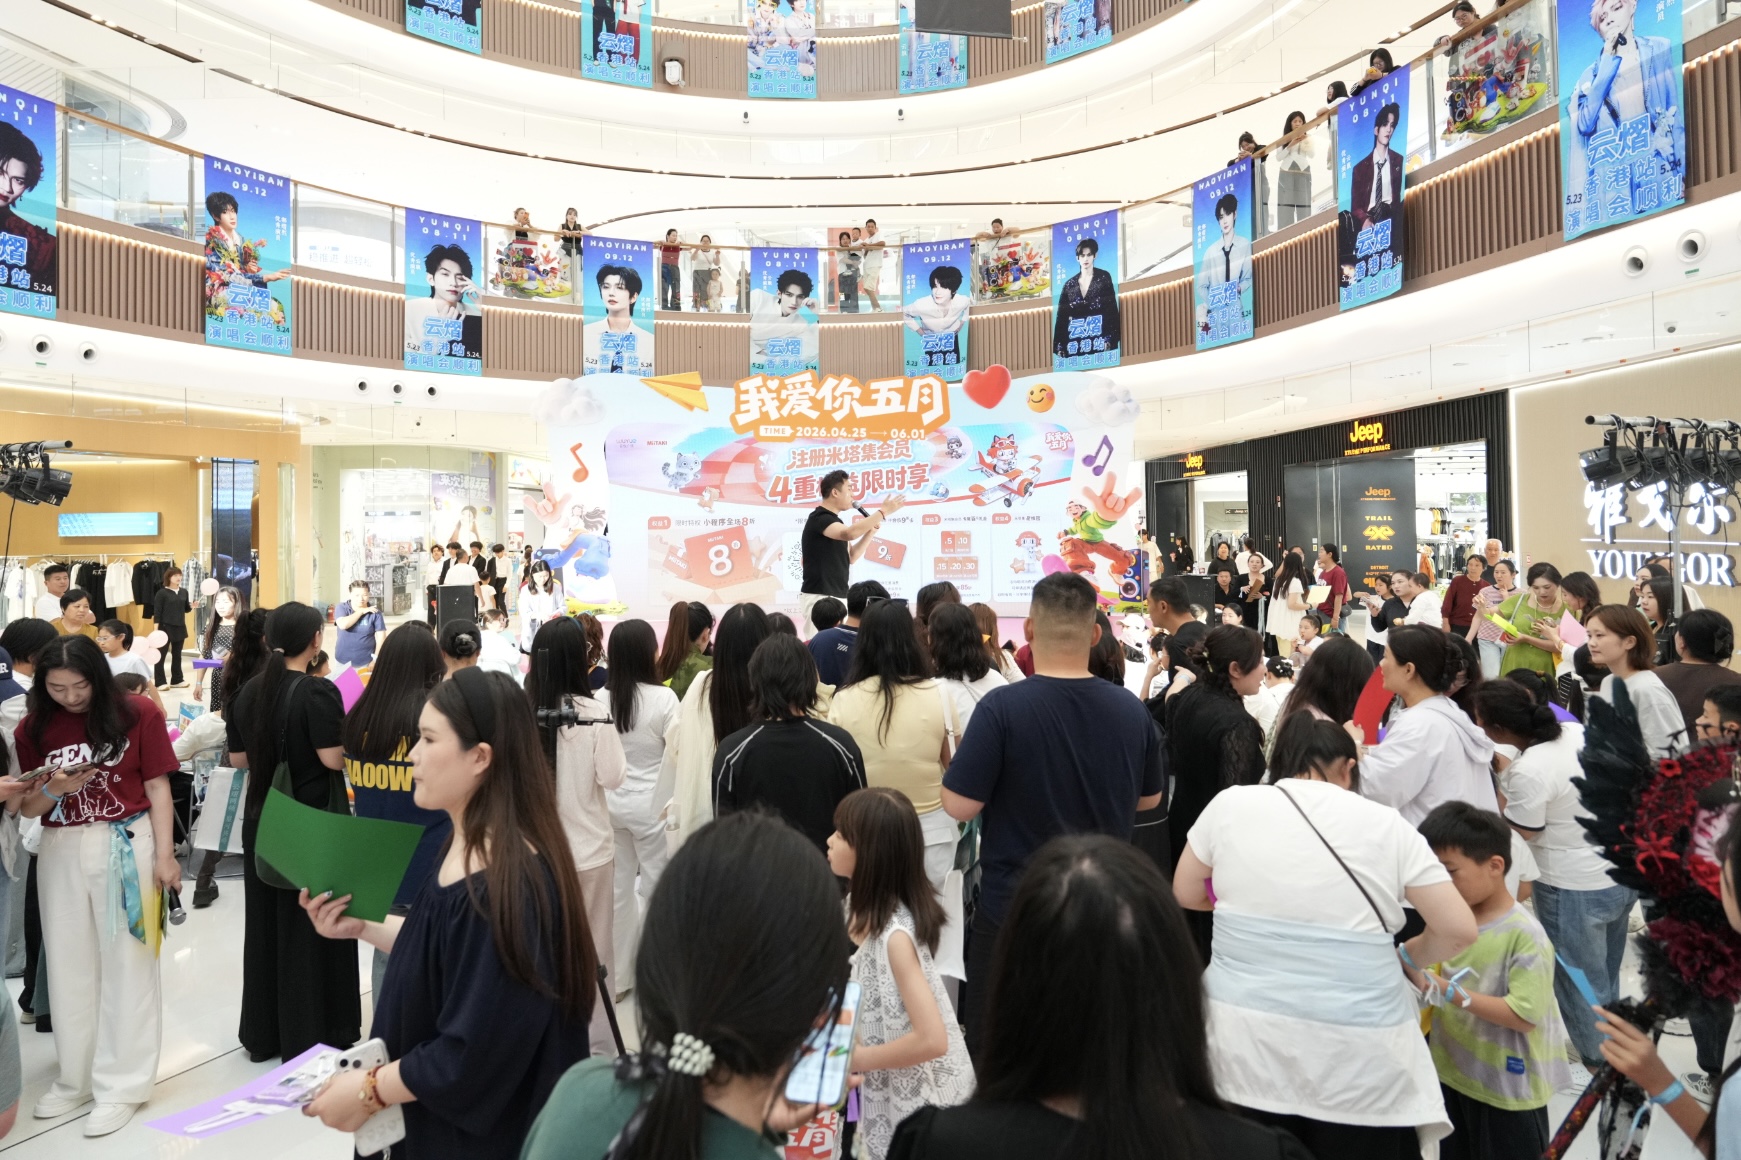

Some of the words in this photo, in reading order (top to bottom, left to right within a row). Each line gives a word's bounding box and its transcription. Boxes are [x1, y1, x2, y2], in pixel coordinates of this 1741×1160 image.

[422, 6, 466, 29] 香港站
[467, 27, 479, 35] 5.24
[409, 16, 479, 49] 演唱会顺利
[1047, 27, 1111, 57] 演唱会顺利
[598, 32, 634, 55] 云熠
[917, 40, 950, 60] 云熠
[597, 52, 637, 68] 香港站
[765, 48, 799, 67] 云熠
[584, 64, 650, 83] 演唱会顺利
[764, 70, 801, 80] 香港站
[902, 72, 965, 90] 演唱会顺利
[750, 82, 814, 94] 演唱会顺利
[1349, 77, 1398, 112] YUNQI
[1353, 93, 1396, 124] 08.11
[1588, 113, 1651, 168] 云熠
[213, 160, 284, 187] HAOYIRAN
[1198, 163, 1247, 191] HAOYIRAN
[1566, 193, 1583, 205] 5.23
[1585, 156, 1657, 198] 香港站
[1660, 159, 1682, 175] 5.24
[232, 181, 267, 197] 09.12
[1209, 183, 1235, 199] 09.12
[1566, 173, 1684, 234] 演唱会顺利
[419, 216, 470, 232] YUNQI
[1064, 218, 1108, 234] YUNQI
[422, 227, 467, 241] 08.11
[1066, 228, 1106, 243] 08.11
[1356, 219, 1392, 259] 云熠
[590, 240, 647, 252] HAOYIRAN
[762, 251, 808, 260] YUNQI
[910, 242, 965, 253] HAOYIRAN
[604, 252, 633, 262] 09.12
[924, 255, 951, 263] 09.12
[1355, 251, 1393, 279] 香港站
[33, 282, 53, 293] 5.24
[1209, 280, 1238, 308] 云熠
[1342, 267, 1402, 303] 演唱会顺利
[228, 283, 272, 311] 云熠
[227, 310, 274, 330] 香港站
[276, 325, 290, 333] 5.24
[1208, 306, 1240, 326] 香港站
[209, 324, 289, 349] 演唱会顺利
[424, 316, 463, 341] 云熠
[1068, 315, 1103, 339] 云熠
[1198, 320, 1250, 346] 演唱会顺利
[406, 342, 420, 352] 5.23
[422, 340, 465, 357] 香港站
[466, 350, 480, 358] 5.24
[602, 333, 637, 351] 云熠
[768, 339, 802, 357] 云熠
[921, 332, 955, 352] 云熠
[1067, 338, 1106, 355] 香港站
[407, 353, 479, 372] 演唱会顺利
[585, 357, 598, 365] 5.23
[600, 354, 639, 367] 香港站
[752, 362, 764, 370] 5.23
[766, 359, 803, 370] 香港站
[920, 352, 957, 366] 香港站
[1056, 351, 1118, 369] 演唱会顺利
[735, 372, 944, 427] 我爱你五月
[763, 427, 787, 435] TIME
[796, 426, 867, 438] 2026.04.25
[890, 428, 925, 440] 06.01
[1350, 421, 1383, 444] Jeep
[786, 440, 912, 471] 注册米塔集会员
[1186, 453, 1203, 470] Jeep
[1365, 487, 1391, 498] Jeep
[708, 543, 733, 577] 8
